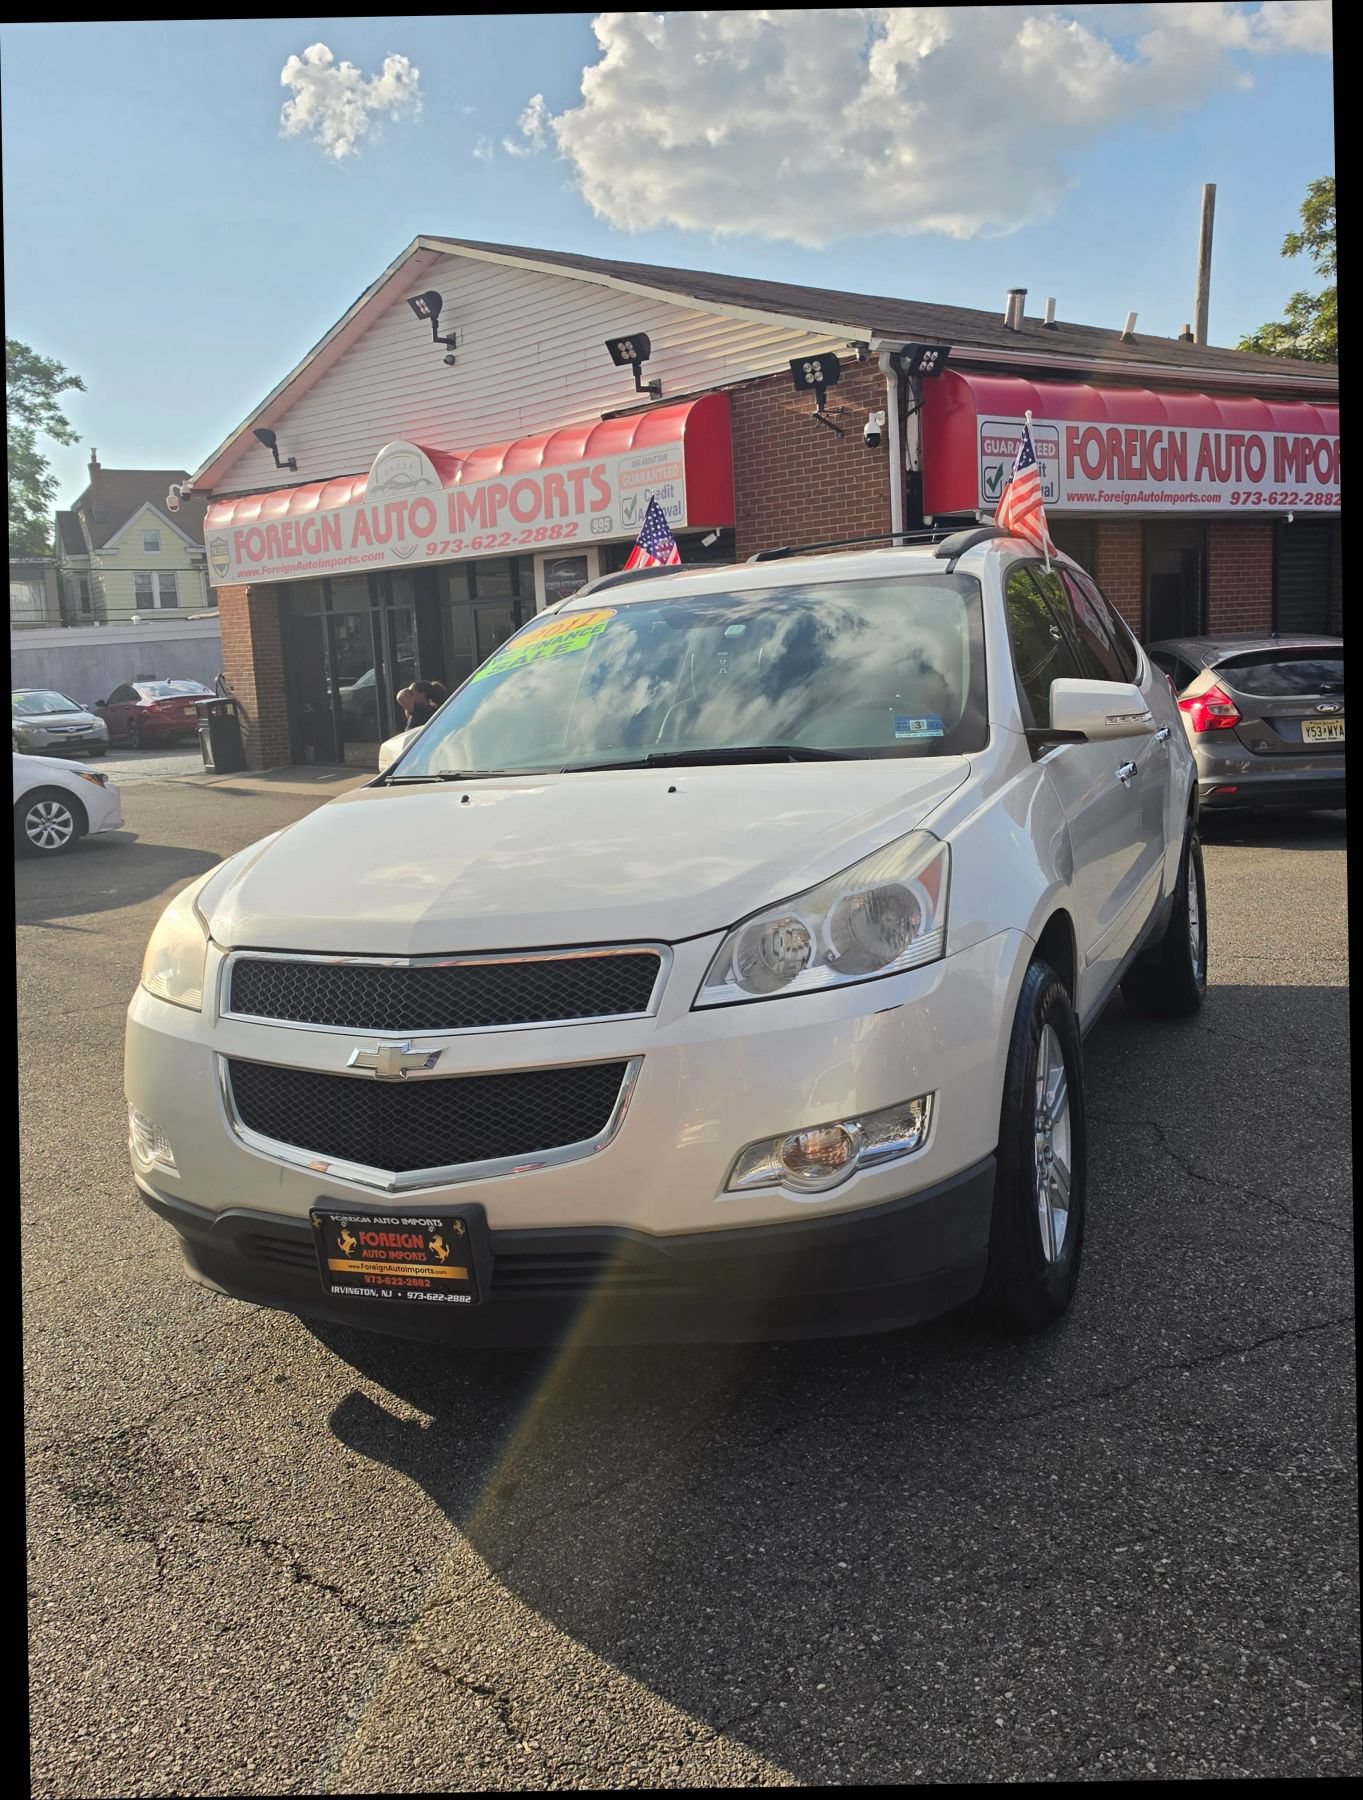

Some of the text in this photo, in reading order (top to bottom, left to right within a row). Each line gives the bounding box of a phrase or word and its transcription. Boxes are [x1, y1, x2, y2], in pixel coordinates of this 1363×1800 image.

[1066, 426, 1187, 482] FOREIGN
[1194, 432, 1266, 483] AUTO
[1066, 490, 1221, 505] www.ForeignAutoImports.com
[1229, 490, 1341, 506] 973-622-2882
[233, 463, 612, 564] FOREIGN AUTO IMPORTS
[592, 518, 611, 533] 995
[425, 521, 579, 557] 973-622-2882
[237, 552, 385, 579] www.ForeignAutoImports.com
[914, 721, 922, 729] 3
[373, 1217, 400, 1225] AUTO
[401, 1218, 443, 1227] IMPORTS
[359, 1231, 425, 1249] FOREIGN
[362, 1250, 427, 1262] AUTO IMPORTS
[348, 1263, 448, 1276] www.ForeignAutoImports.com
[364, 1275, 432, 1288] 973-622-2882
[331, 1286, 472, 1304] IRVINGTON, NJ 973-622-2882
